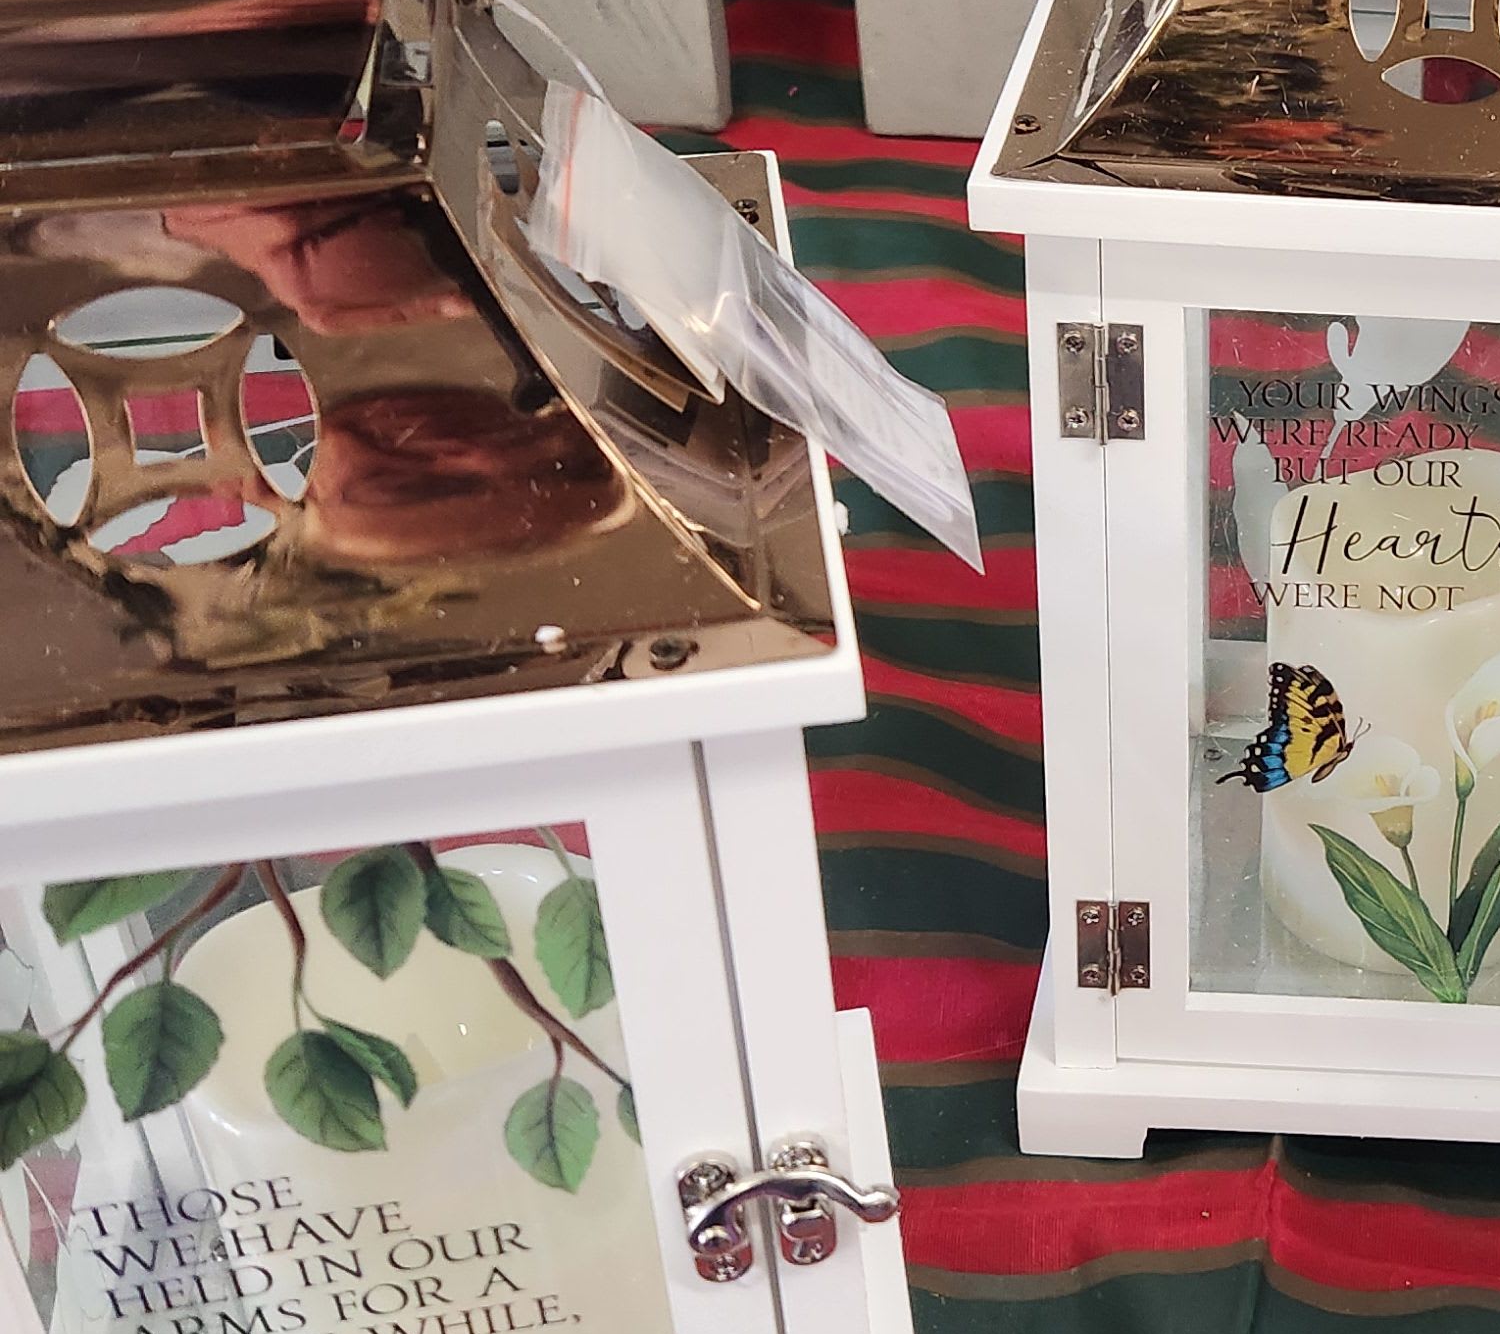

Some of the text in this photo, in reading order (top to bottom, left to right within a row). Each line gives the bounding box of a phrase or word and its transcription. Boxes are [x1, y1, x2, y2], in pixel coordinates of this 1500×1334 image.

[1238, 379, 1352, 411] YOUR
[1211, 416, 1480, 451] WERE READY
[1273, 456, 1464, 488] BUT OUR
[1250, 582, 1466, 613] WERE NOT
[76, 1176, 303, 1237] THOSE
[91, 1201, 411, 1278] WE HAVE
[106, 1222, 534, 1319] HELD IN OUR
[331, 1276, 452, 1322] FOR
[482, 1266, 526, 1297] A
